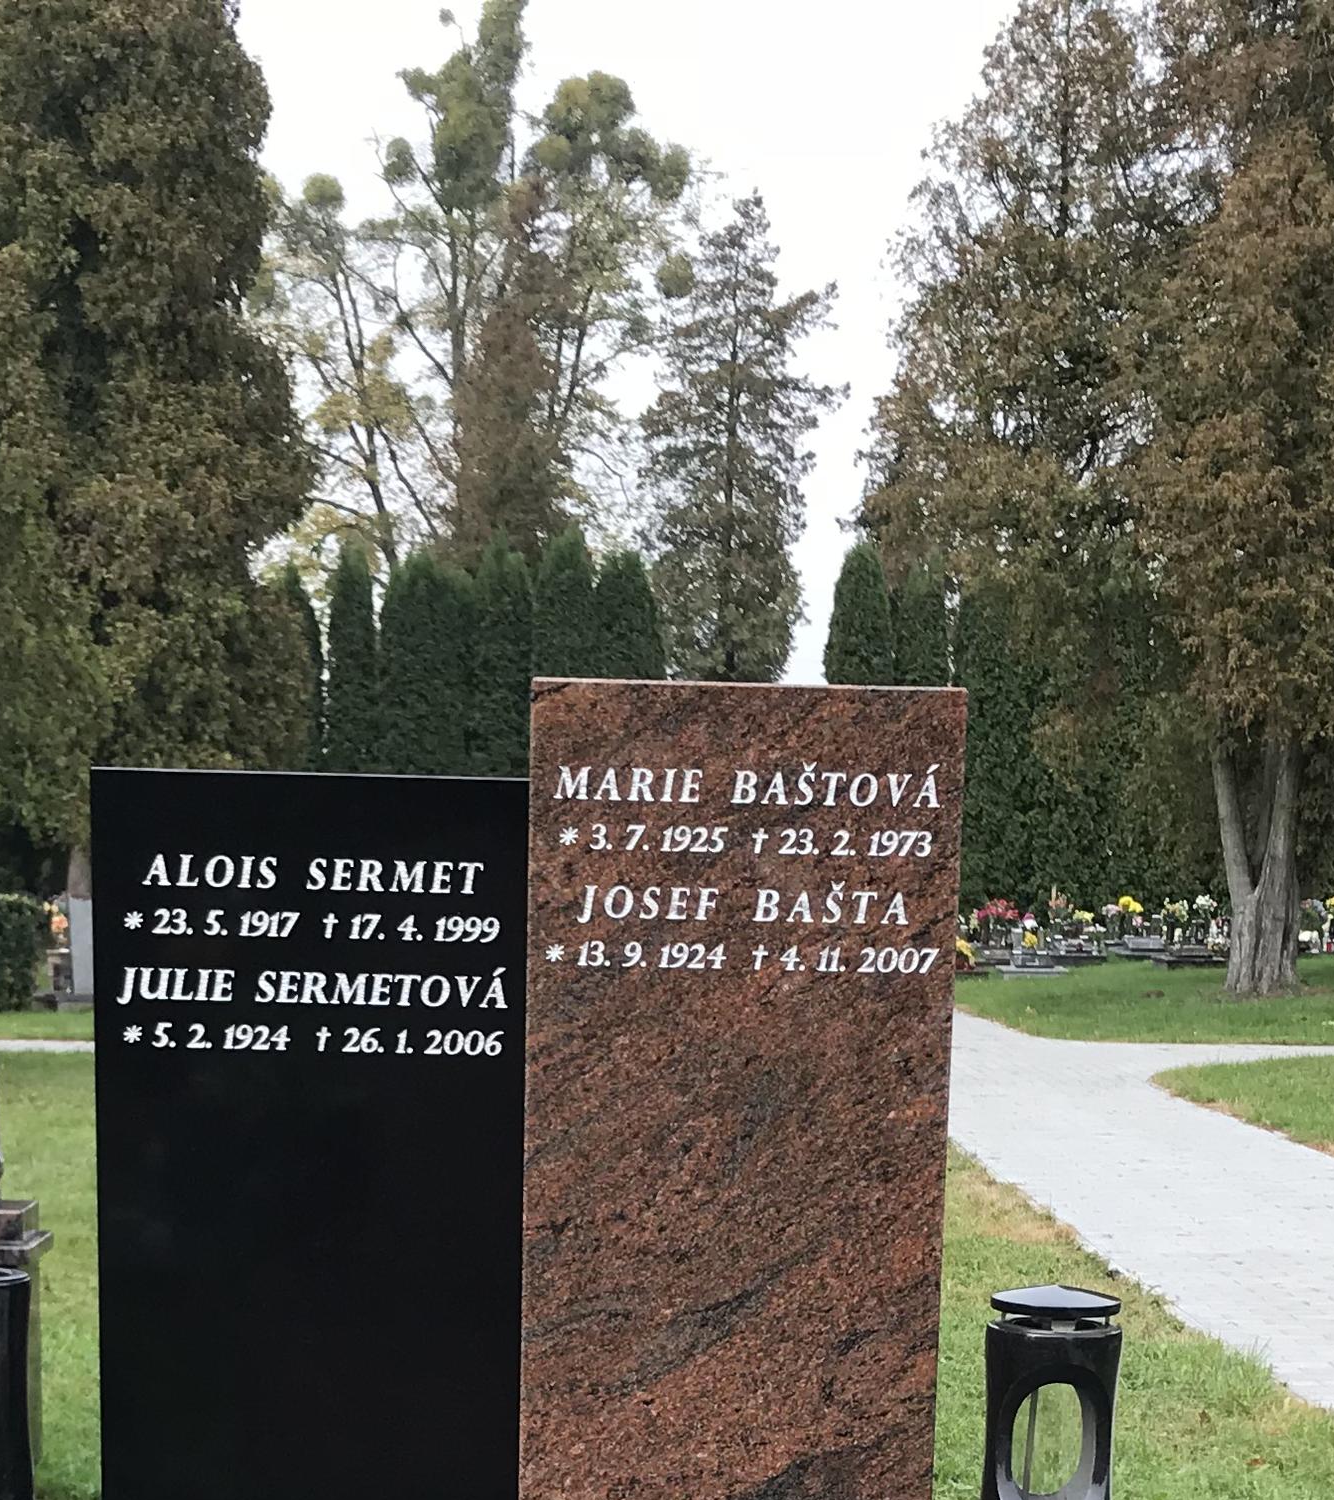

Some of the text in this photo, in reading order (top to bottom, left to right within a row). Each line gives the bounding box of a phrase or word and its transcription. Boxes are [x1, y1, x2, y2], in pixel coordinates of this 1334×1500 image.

[553, 761, 941, 808] MARIE BAŠTOVÁ
[589, 823, 933, 858] 3. 7. 1925 23. 2. 1973
[141, 853, 485, 895] ALOIS SERMET
[576, 880, 909, 926] JOSEF BAŠTA
[151, 908, 501, 944] 23. 5. 1917 17. 4. 1999
[577, 940, 941, 975] 13. 9. 1924 4. 11. 2007
[116, 966, 509, 1010] JULIE SERMETOVÁ
[151, 1021, 504, 1057] 5. 2. 1924 26. 1. 2006
